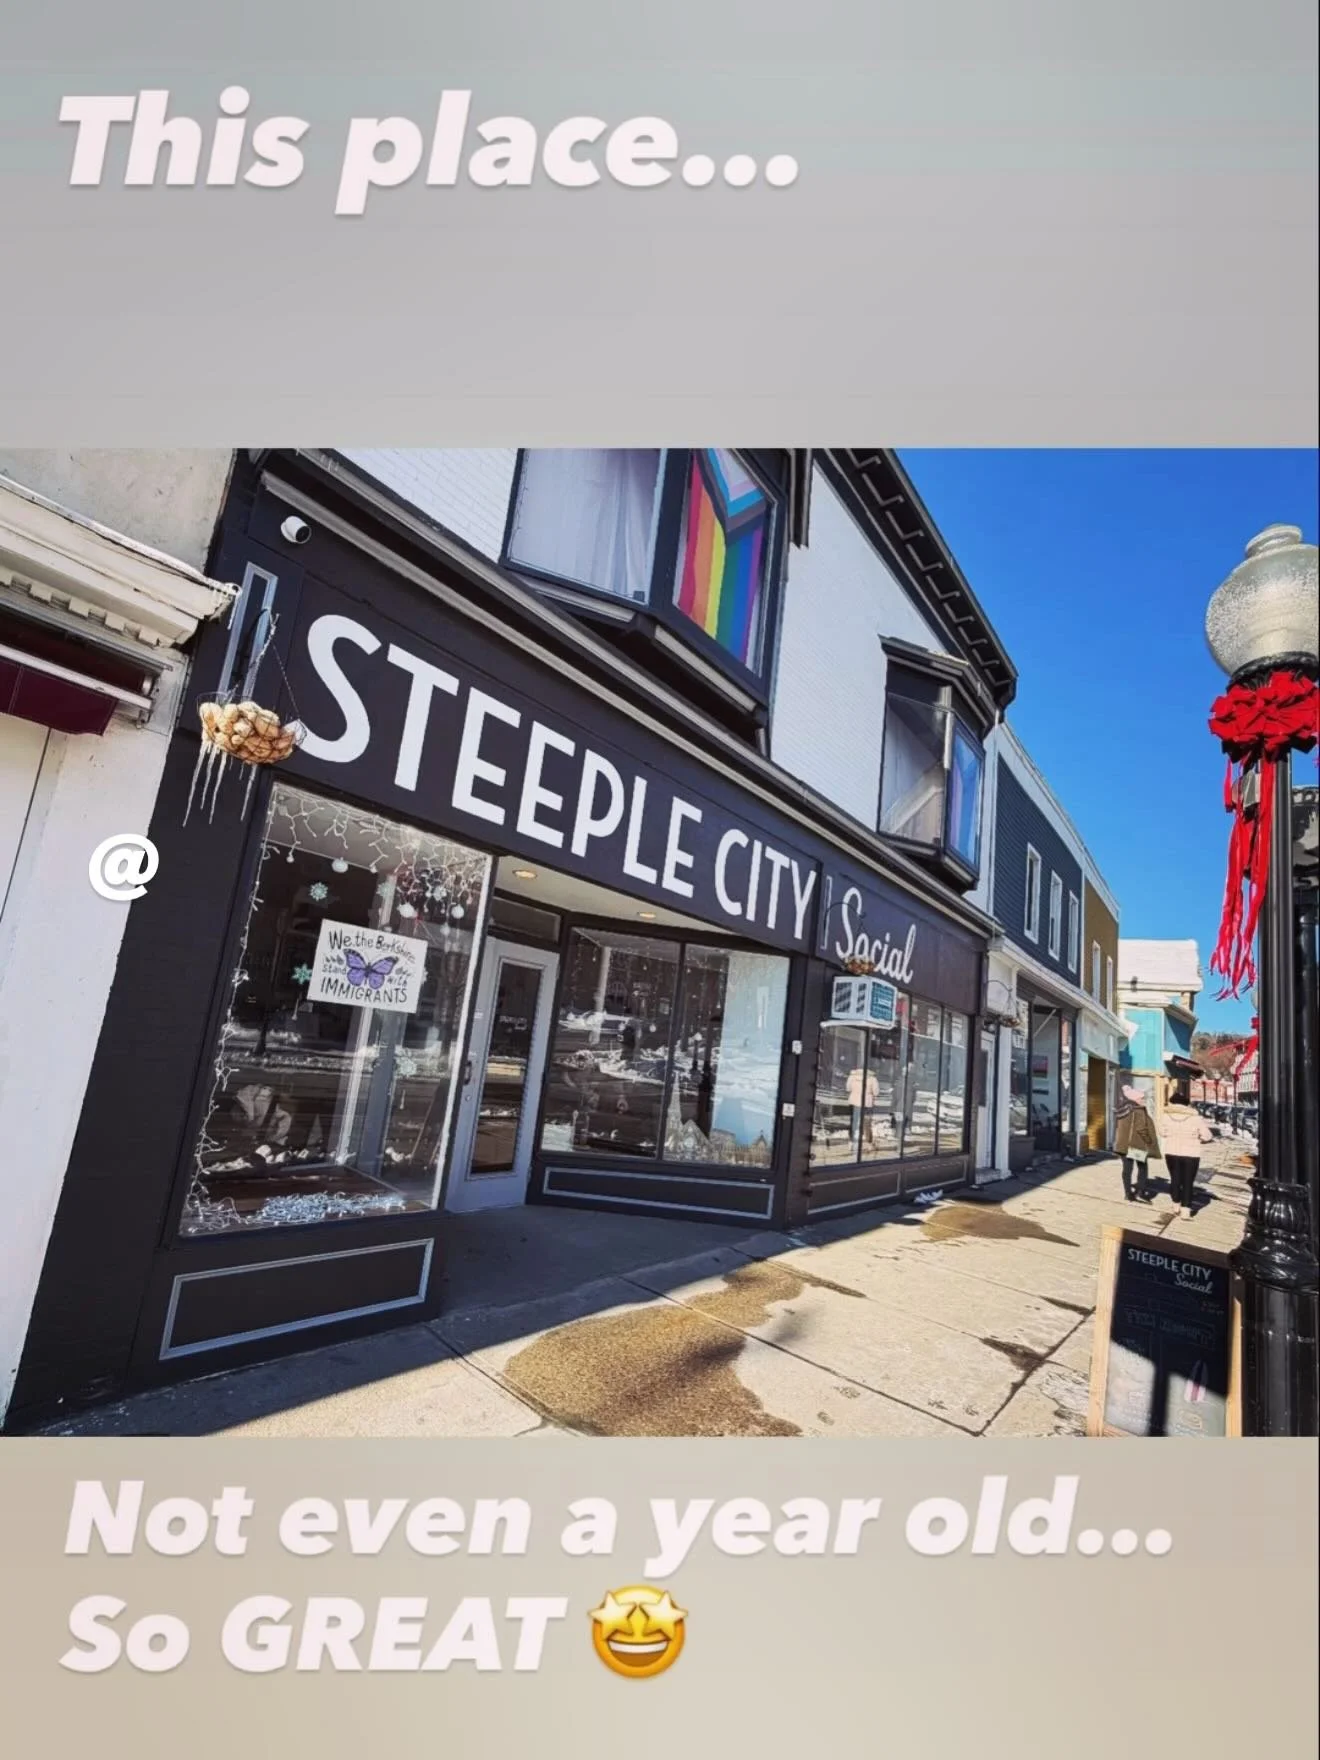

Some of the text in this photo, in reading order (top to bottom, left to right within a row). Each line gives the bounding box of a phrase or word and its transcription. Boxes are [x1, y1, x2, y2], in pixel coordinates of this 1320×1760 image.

[284, 614, 817, 940] STEEPLE CITY
[355, 931, 374, 949] the
[836, 887, 917, 984] Social
[320, 976, 408, 1004] IMMIGRANTS
[1128, 1248, 1212, 1281] STEEPLE CITY
[1175, 1273, 1213, 1294] Social
